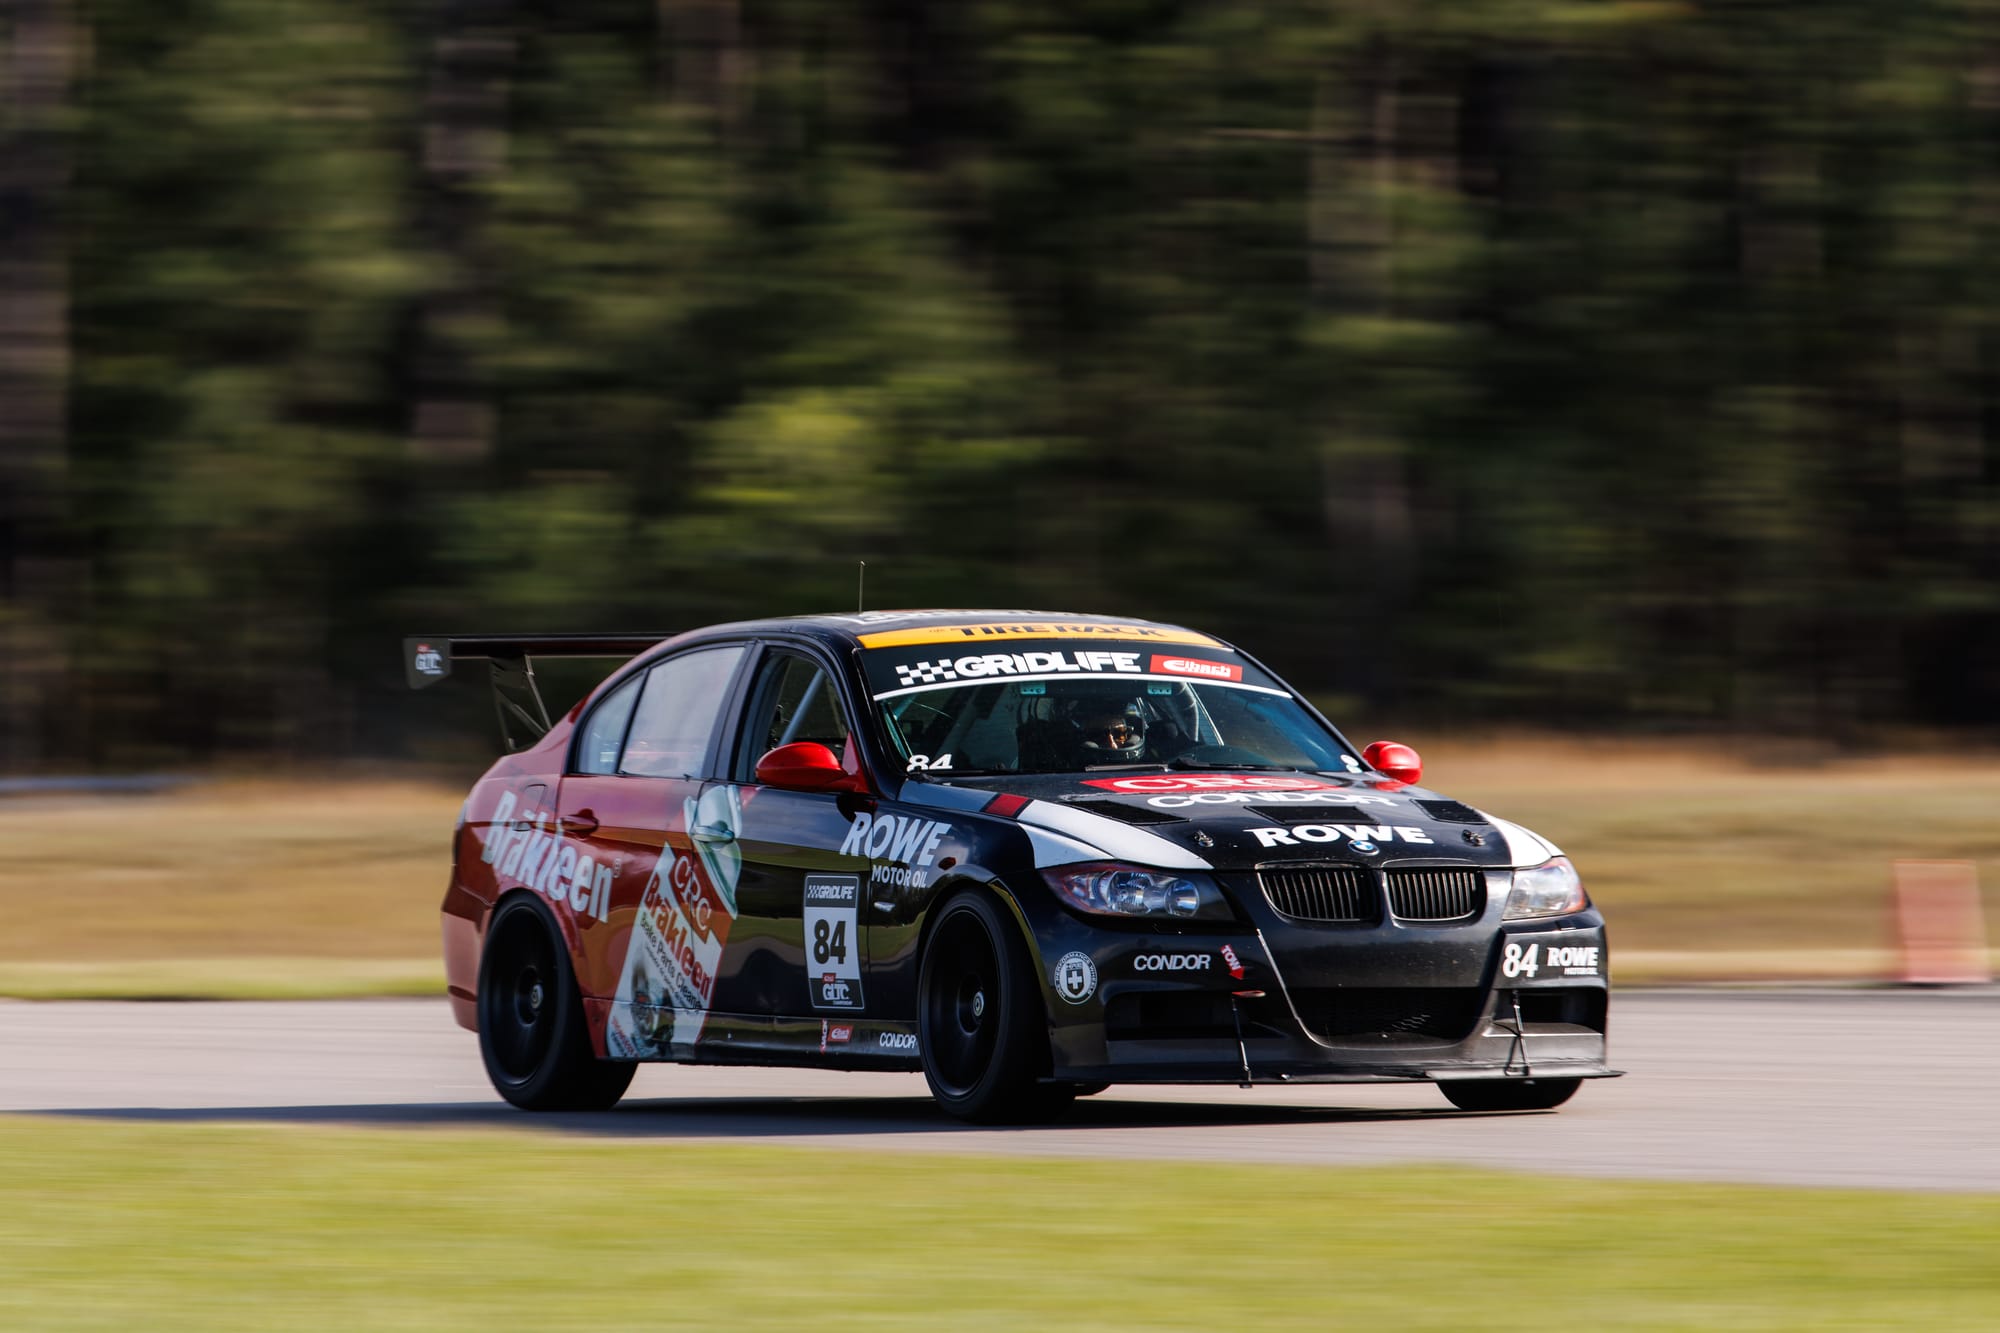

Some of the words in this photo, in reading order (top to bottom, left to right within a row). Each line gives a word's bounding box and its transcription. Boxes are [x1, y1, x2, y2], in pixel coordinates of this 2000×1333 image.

[951, 624, 1050, 636] TIRE
[1055, 624, 1168, 638] RACK
[954, 651, 1142, 677] GRIDLIFE
[906, 753, 953, 772] 84
[1147, 791, 1400, 808] CONDOR
[839, 811, 952, 866] ROWE
[1244, 824, 1434, 847] ROWE
[871, 865, 911, 886] MOTOR
[912, 869, 927, 889] OIL
[674, 855, 713, 932] CRC
[817, 885, 856, 900] GRIDLIFE
[813, 919, 847, 965] 84
[1133, 953, 1211, 971] CONDOR
[1221, 944, 1242, 971] TOW
[1502, 943, 1539, 978] 84
[1546, 946, 1600, 967] ROWE
[879, 1032, 917, 1049] CONDOR
